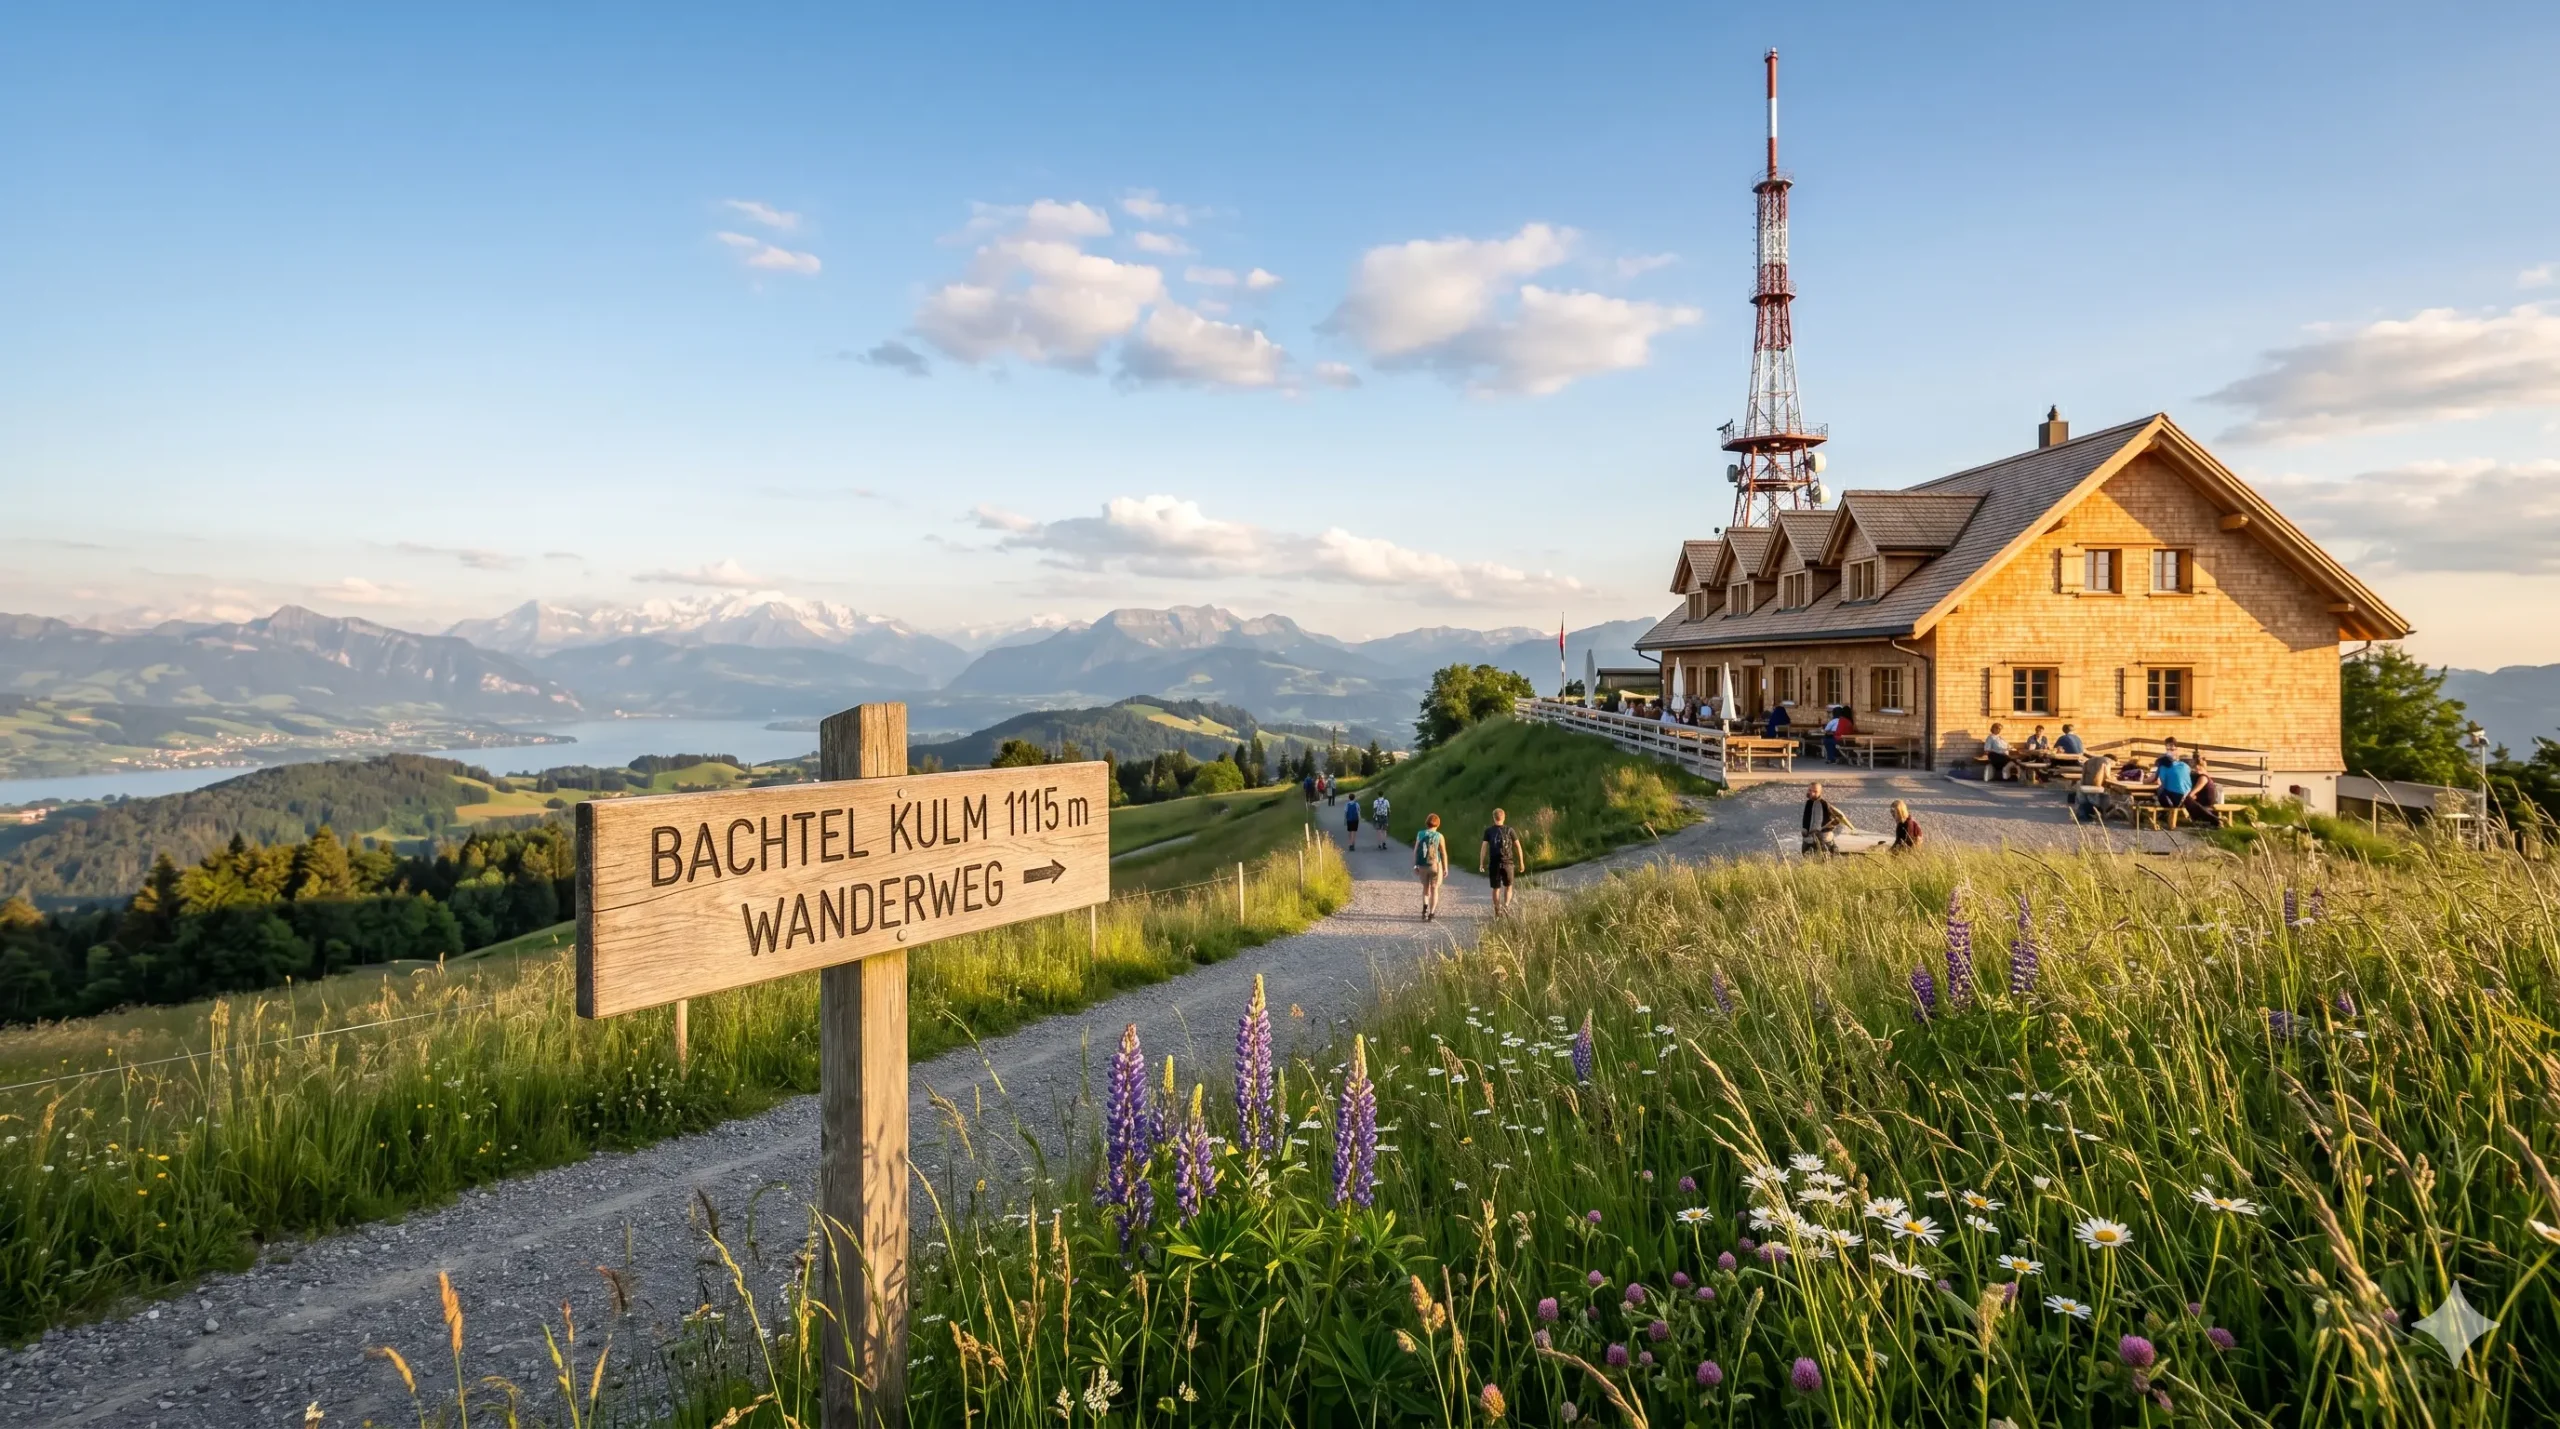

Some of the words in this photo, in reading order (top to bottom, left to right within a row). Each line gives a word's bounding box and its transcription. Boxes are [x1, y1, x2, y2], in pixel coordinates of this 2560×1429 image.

[651, 807, 869, 887] BACHTEL
[890, 794, 987, 854] KULM
[1004, 786, 1059, 837] 1115
[1068, 795, 1089, 827] m
[742, 860, 1004, 956] WANDERWEG
